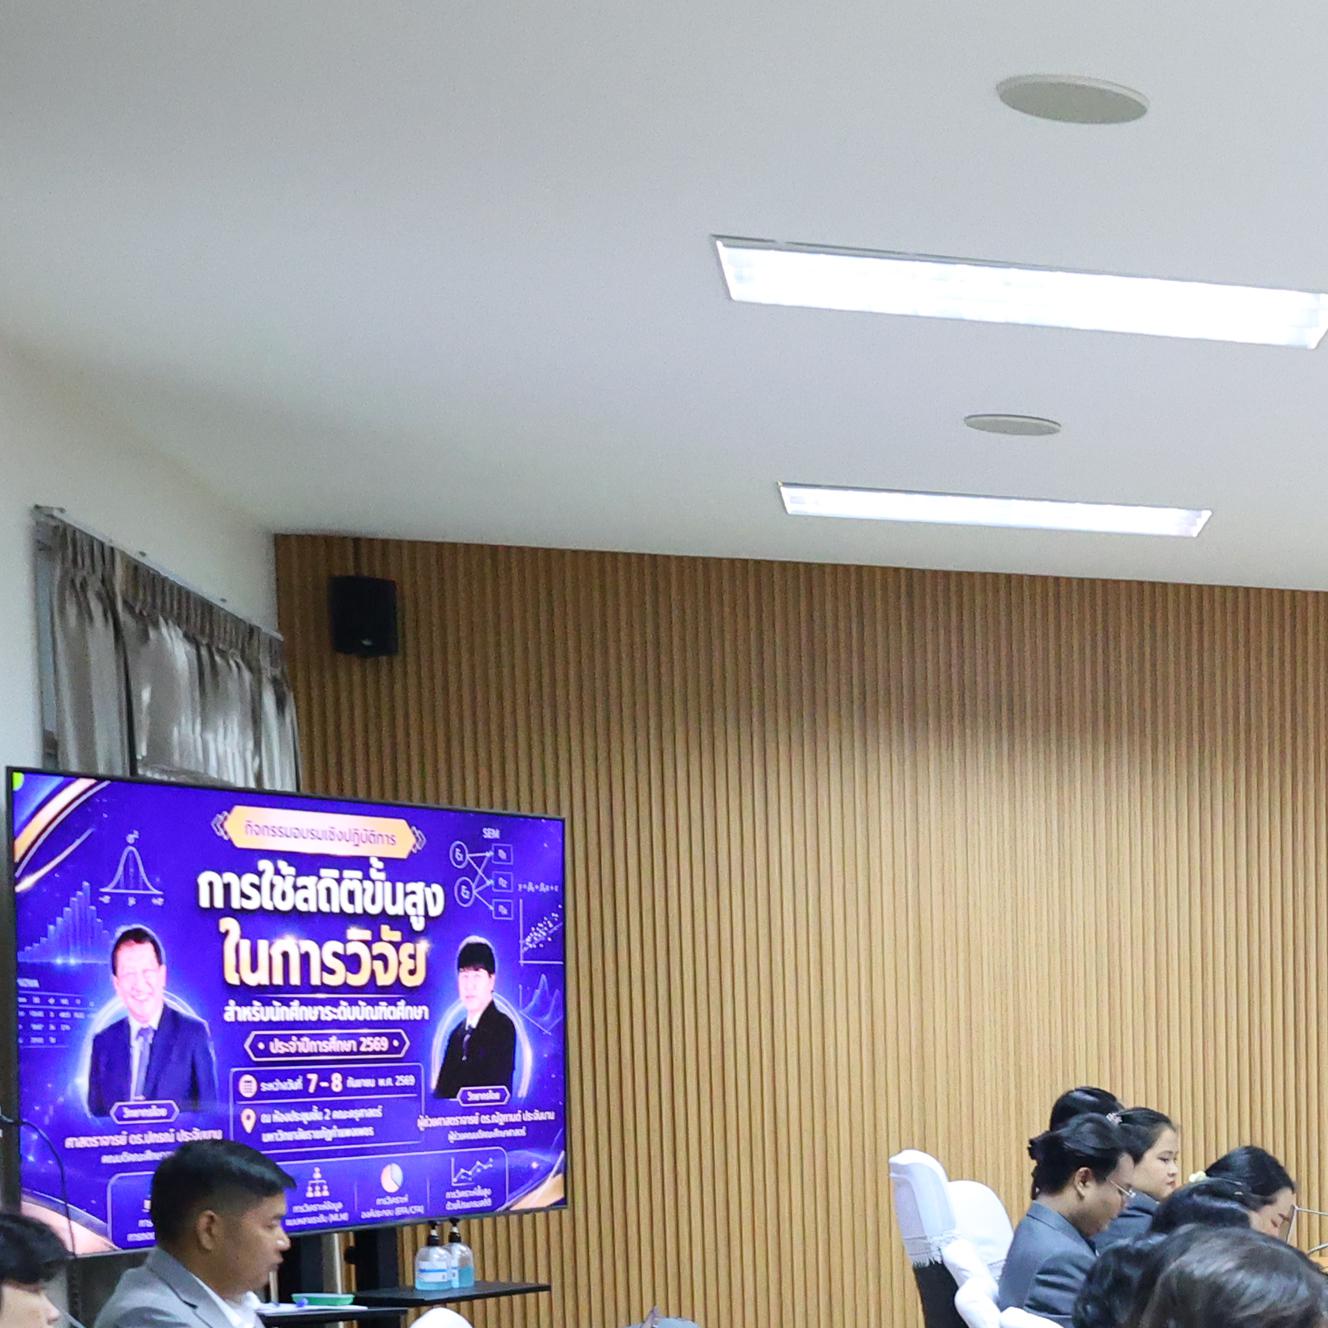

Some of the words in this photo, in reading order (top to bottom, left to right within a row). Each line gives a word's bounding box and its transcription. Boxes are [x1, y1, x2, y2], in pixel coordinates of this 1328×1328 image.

[197, 857, 445, 931] การใช้สถิติขั้นสูง
[219, 917, 429, 987] ในการวิจัย
[224, 999, 429, 1022] สำหรับนักศึกษาระดับบัณฑิตศึกษา
[359, 1036, 389, 1052] 2569
